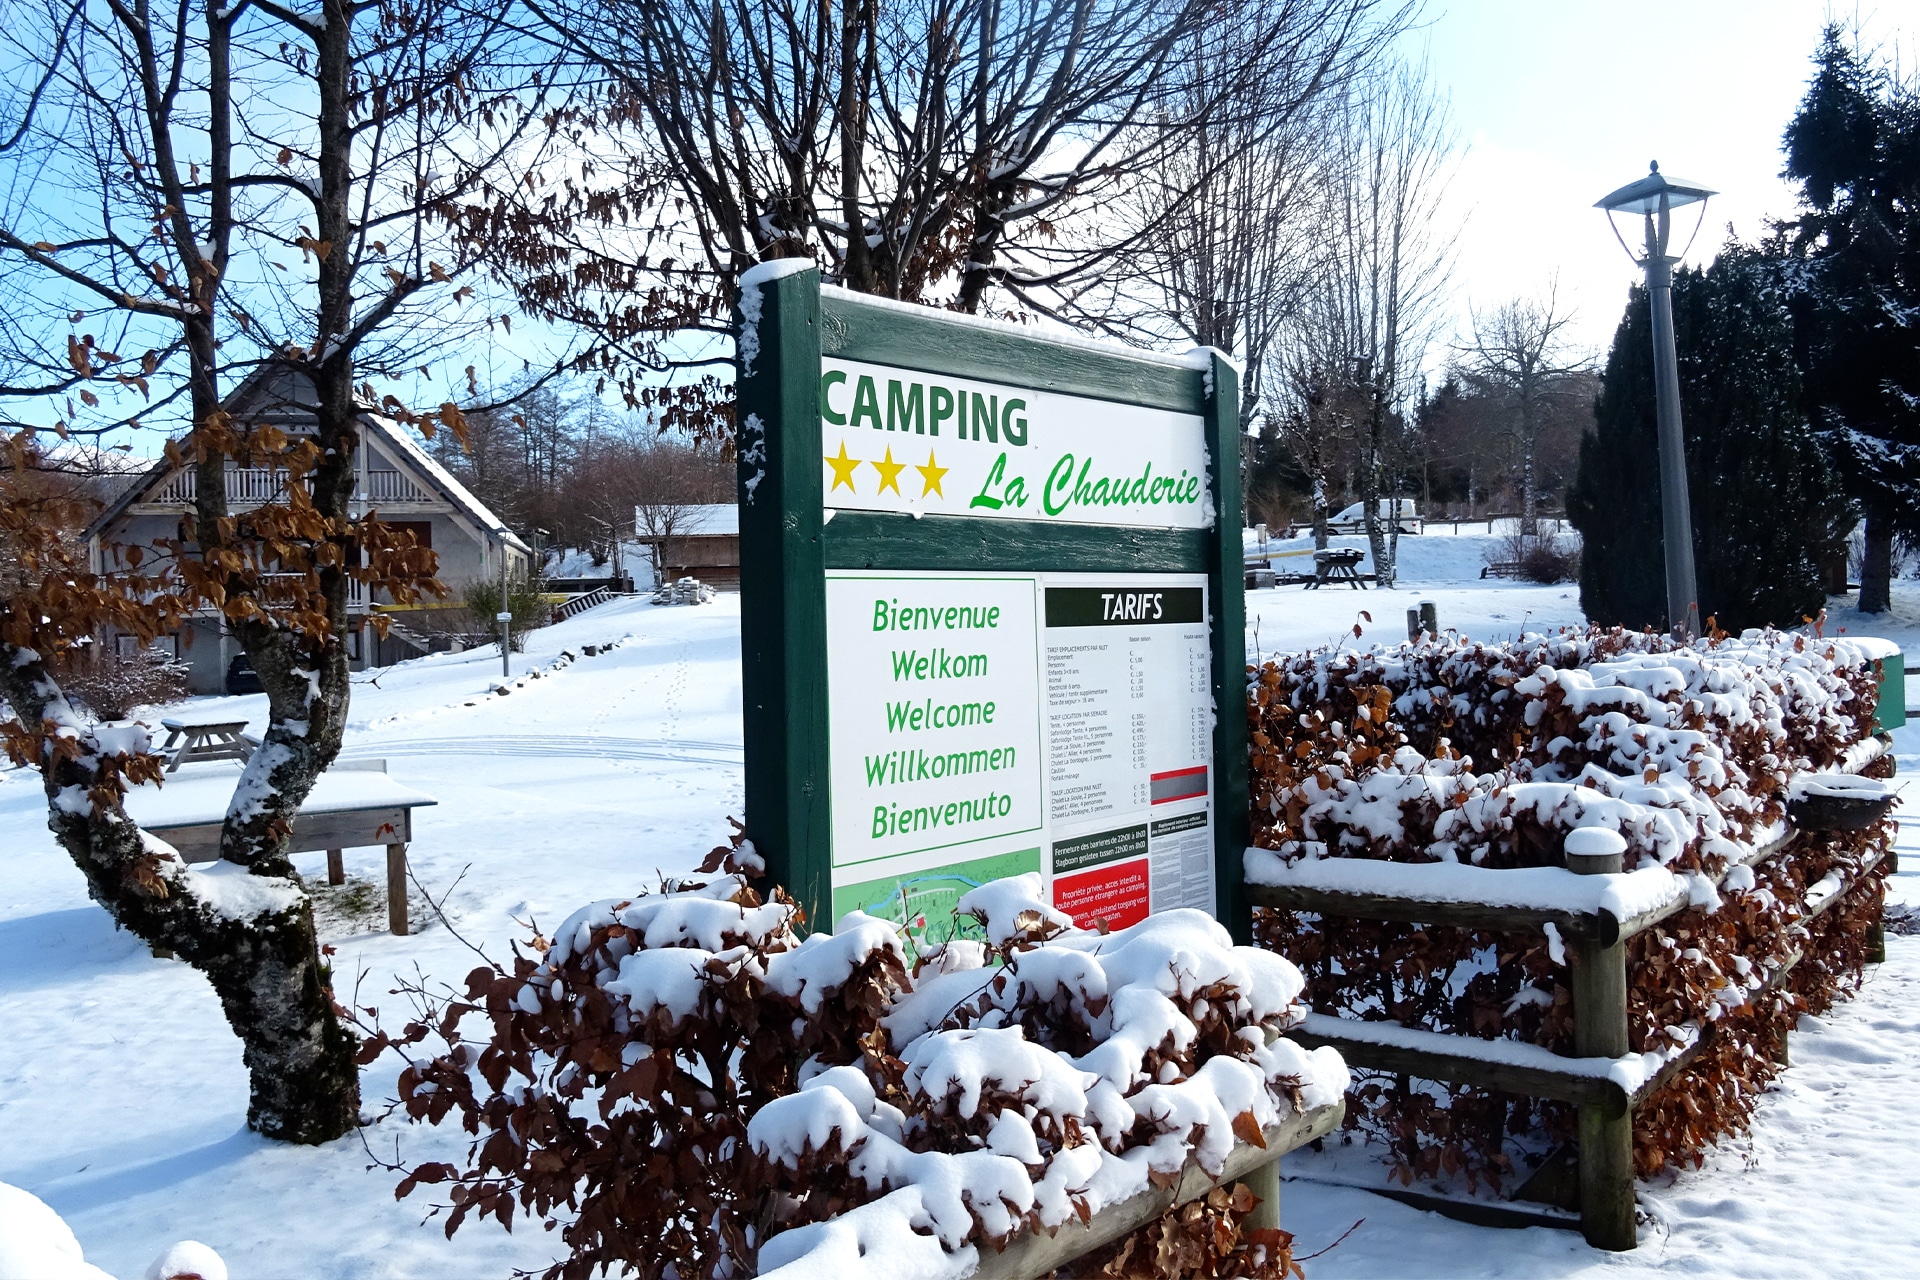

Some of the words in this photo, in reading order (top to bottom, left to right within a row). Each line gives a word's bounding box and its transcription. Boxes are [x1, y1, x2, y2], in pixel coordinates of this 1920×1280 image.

[821, 370, 1028, 446] CAMPING
[969, 452, 1030, 510] La
[1043, 453, 1200, 516] Chauderie
[872, 598, 1000, 632] Bienvenue
[1101, 593, 1163, 620] TARIFS
[892, 648, 988, 682] Welkom
[886, 698, 996, 733] Welcome
[865, 746, 1016, 788] Willkommen
[872, 791, 1012, 839] Bienvenuto
[1054, 845, 1080, 856] Fermeture
[1080, 842, 1090, 851] des
[1055, 856, 1079, 868] Slagboom
[1079, 853, 1099, 864] gesloten
[1099, 849, 1115, 858] tussen
[1128, 843, 1135, 851] en
[1119, 874, 1137, 885] interdit
[1070, 895, 1094, 907] personne
[1090, 904, 1117, 917] uitsluitend
[1117, 899, 1137, 910] toegang
[1136, 895, 1148, 904] voor
